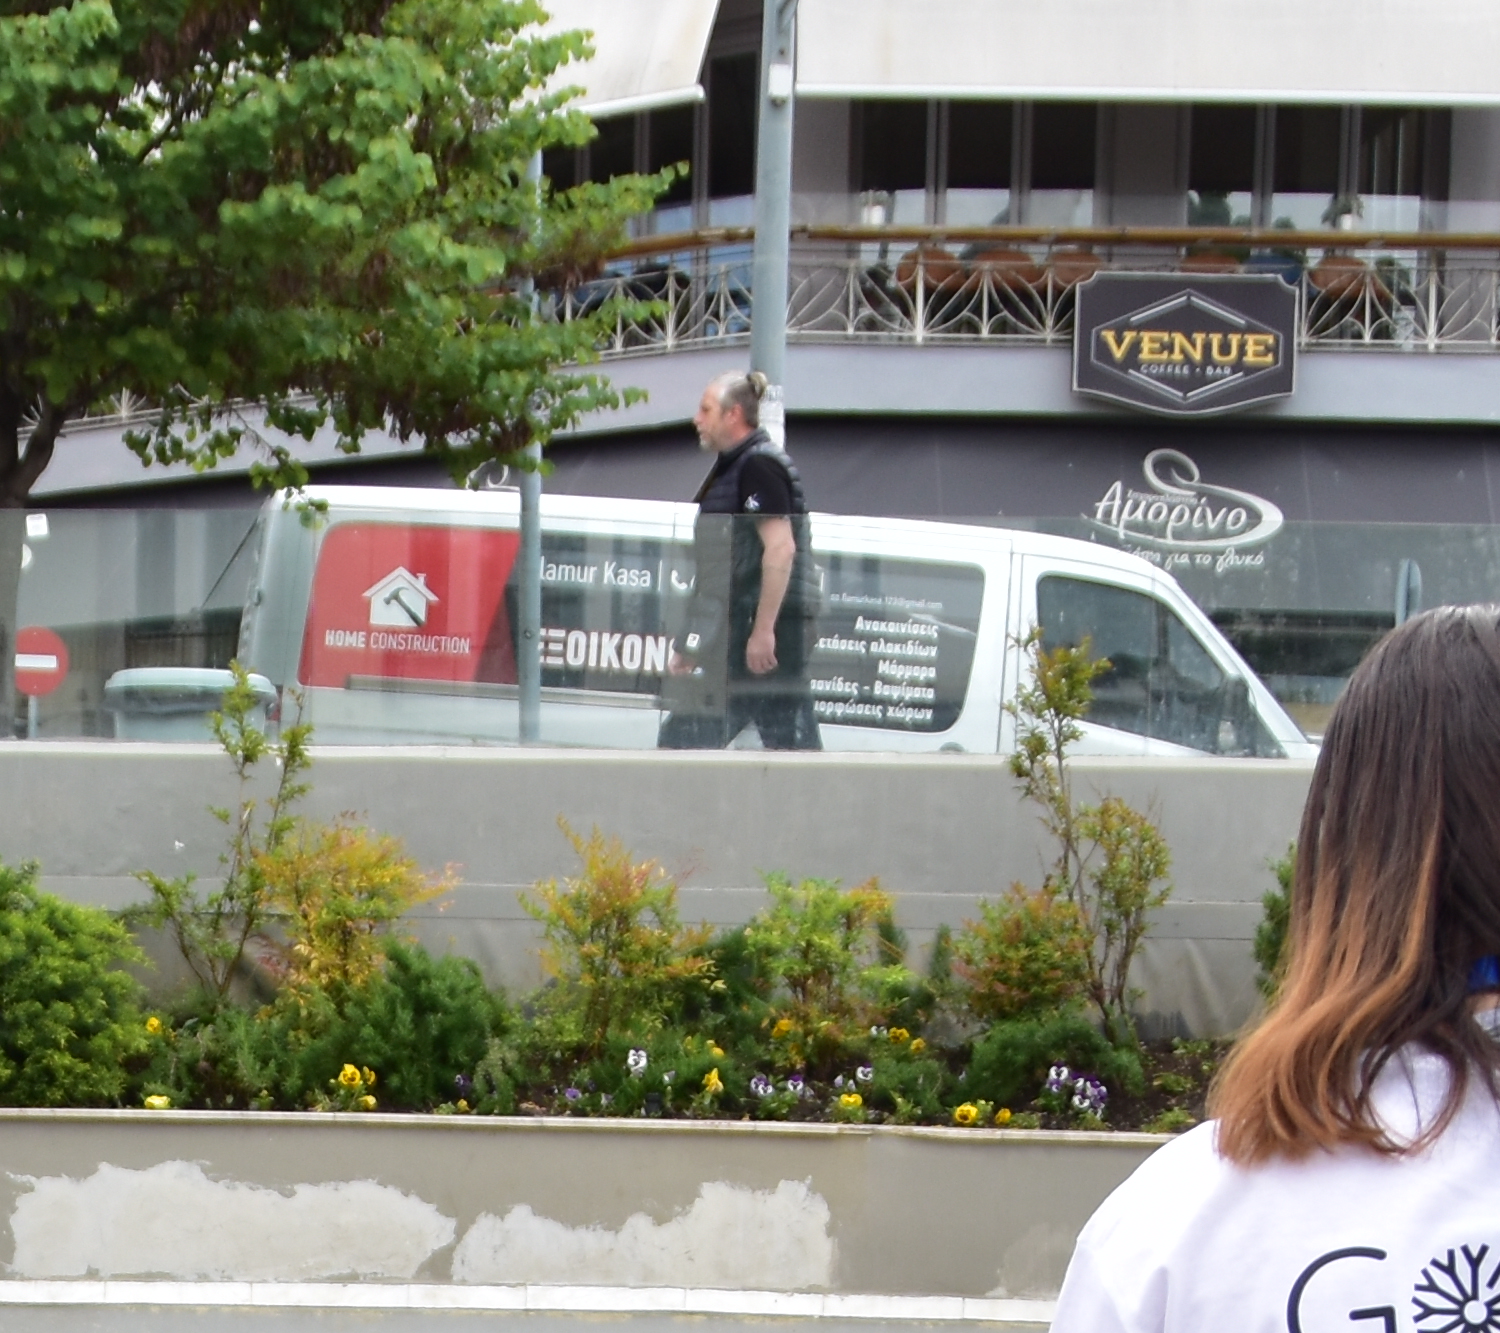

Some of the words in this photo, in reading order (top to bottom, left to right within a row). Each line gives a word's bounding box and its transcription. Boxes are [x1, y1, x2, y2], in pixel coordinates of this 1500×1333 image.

[1099, 328, 1275, 366] VENUE
[1139, 362, 1190, 375] COFFEE
[1205, 364, 1233, 376] BAR
[1094, 479, 1248, 541] Αμορίνο
[603, 560, 652, 588] Kasa
[854, 615, 939, 638] Ανακαινίσεις
[325, 629, 367, 648] HOME
[370, 632, 470, 653] CONSTRUCTION
[878, 659, 937, 680] Μάρμαρα
[873, 679, 935, 699] Βαψίματα
[886, 702, 934, 721] χώρων
